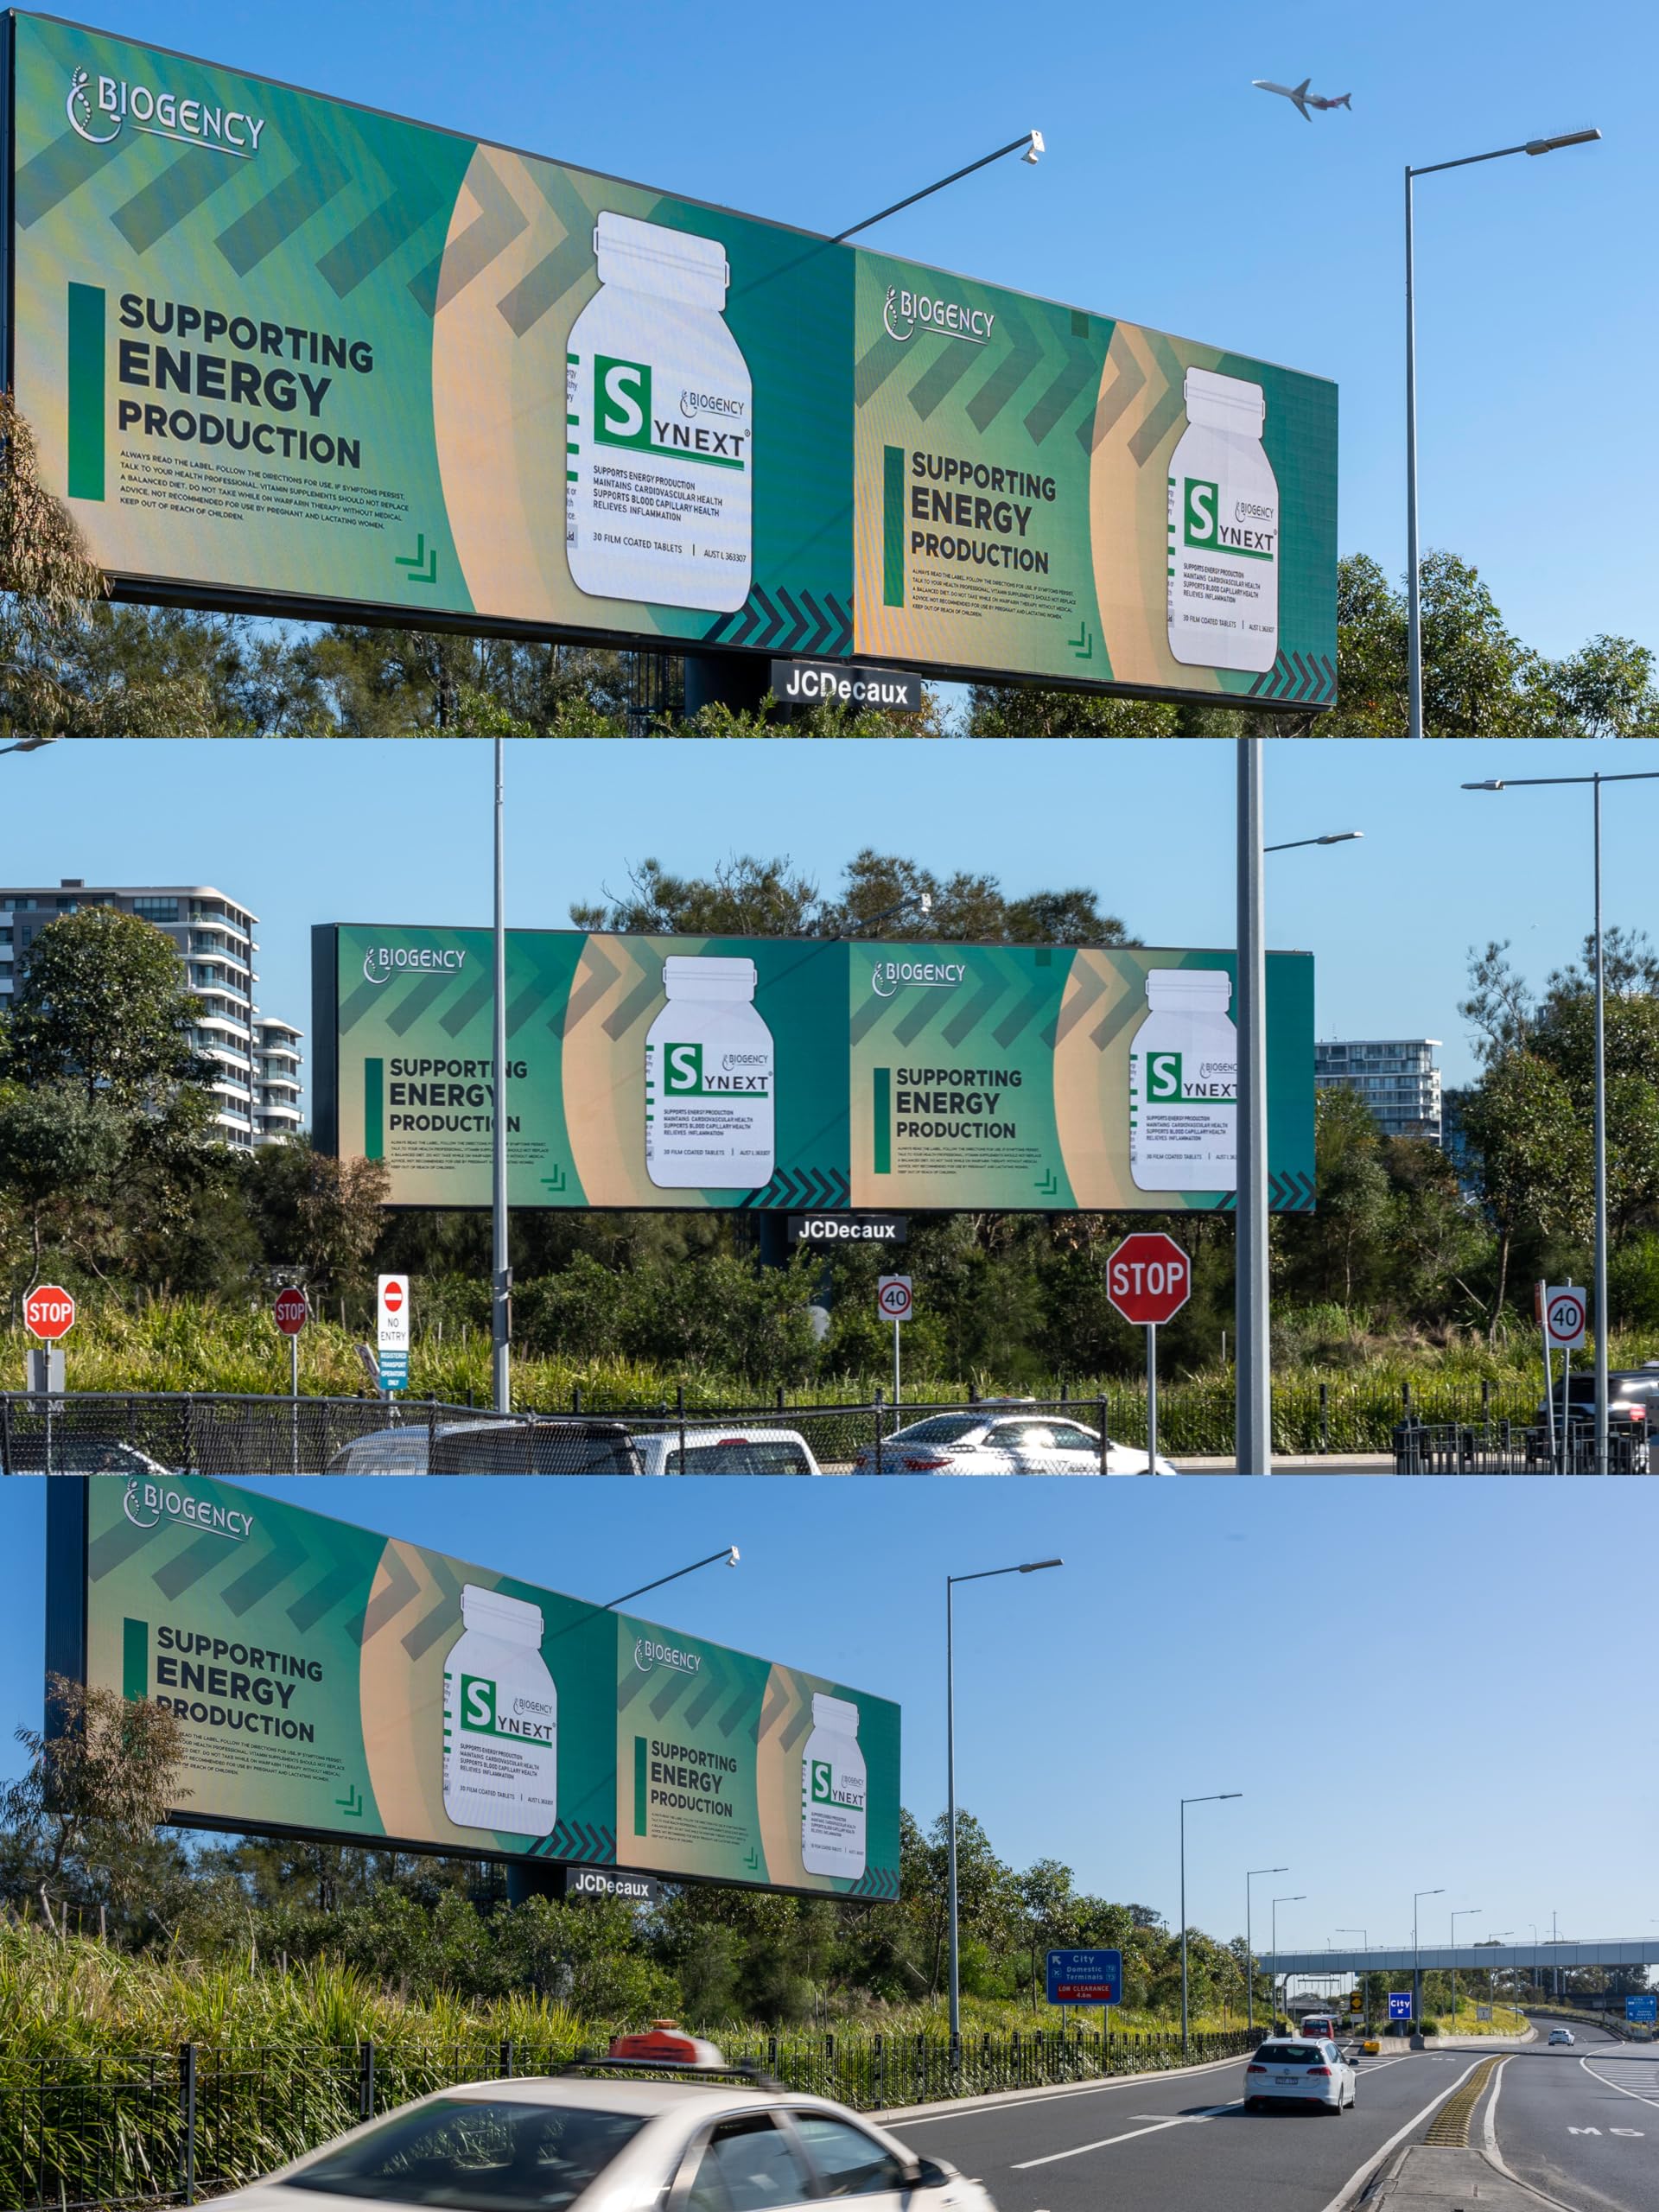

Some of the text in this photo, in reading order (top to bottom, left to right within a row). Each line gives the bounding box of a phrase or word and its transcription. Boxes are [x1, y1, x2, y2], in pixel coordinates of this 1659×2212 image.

[99, 75, 264, 149] BIOGENCY
[901, 290, 995, 337] BIOGENCY
[118, 294, 372, 373] SUPPORTING
[119, 339, 332, 417] ENERGY
[690, 391, 744, 416] BIOGENCY
[118, 399, 360, 469] PRODUCTION
[120, 450, 149, 461] ALWAYS
[152, 455, 172, 464] READ
[175, 458, 188, 467] THE
[216, 465, 245, 475] FOLLOW
[247, 469, 260, 478] THE
[262, 472, 302, 484] DIRECTIONS
[304, 478, 316, 486] FOR
[342, 484, 377, 495] SYMPTOMS
[594, 466, 695, 490] SUPPORTS ENERGY PRODUCTION
[912, 452, 1056, 502] SUPPORTING
[121, 461, 138, 470] TALK
[153, 467, 173, 475] YOUR
[175, 470, 202, 480] HEALTH
[260, 483, 287, 493] VITAMIN
[289, 487, 336, 500] SUPPLEMENTS
[339, 494, 364, 504] SHOULD
[381, 501, 408, 511] REPLACE
[128, 475, 167, 486] BALANCED
[201, 486, 215, 494] NOT
[219, 488, 235, 497] TAKE
[238, 491, 258, 500] WHILE
[274, 496, 308, 507] WARFARIN
[311, 502, 340, 512] THERAPY
[343, 506, 372, 517] WITHOUT
[375, 511, 402, 521] MEDICAL
[594, 477, 722, 506] MAINTAINS CARDIOVASCULAR HEALTH
[120, 497, 138, 505] KEEP
[170, 504, 194, 513] REACH
[168, 493, 223, 506] RECOMMENDED
[267, 506, 302, 518] PREGNANT
[321, 514, 356, 525] LACTATING
[593, 488, 719, 517] SUPPORTS BLOOD CAPILLARY HEALTH
[593, 499, 681, 522] RELIEVES INFLAMMATION
[912, 486, 1032, 536] ENERGY
[1241, 502, 1274, 518] BIOGENCY
[593, 532, 682, 553] 30 FILM COATED TABLETS
[703, 549, 719, 559] AUST
[912, 531, 1048, 574] PRODUCTION
[786, 670, 908, 704] JCDecaux
[379, 948, 466, 969] BIOGENCY
[887, 963, 965, 982] BIOGENCY
[729, 1054, 767, 1064] BIOGENCY
[1206, 1063, 1237, 1071] BIOGENC
[896, 1068, 1021, 1087] SUPPORTING
[896, 1092, 1000, 1115] ENERGY
[390, 1115, 520, 1133] PRODUCTIN
[896, 1122, 1015, 1139] PRODUCTION
[798, 1221, 896, 1238] JCDecaux
[1113, 1262, 1184, 1295] STOP
[885, 1291, 906, 1306] 40
[29, 1303, 71, 1322] STOP
[276, 1303, 305, 1322] STOP
[388, 1318, 399, 1327] NO
[1553, 1307, 1577, 1326] 40
[381, 1332, 406, 1341] ENTRY
[144, 1484, 254, 1536] BIOGENCY
[157, 1626, 323, 1682] SUPPORTING
[645, 1641, 701, 1672] BIOGENCY
[157, 1656, 296, 1709] ENERGY
[519, 1698, 552, 1714] BIOGENCY
[652, 1740, 737, 1773] SUPPORTING
[652, 1761, 722, 1794] ENERGY
[651, 1789, 733, 1818] PRODUCTION
[575, 1873, 649, 1897] JCDecaux
[1073, 1955, 1094, 1964] City
[1390, 1999, 1410, 2008] City
[1567, 2126, 1646, 2137] M5
